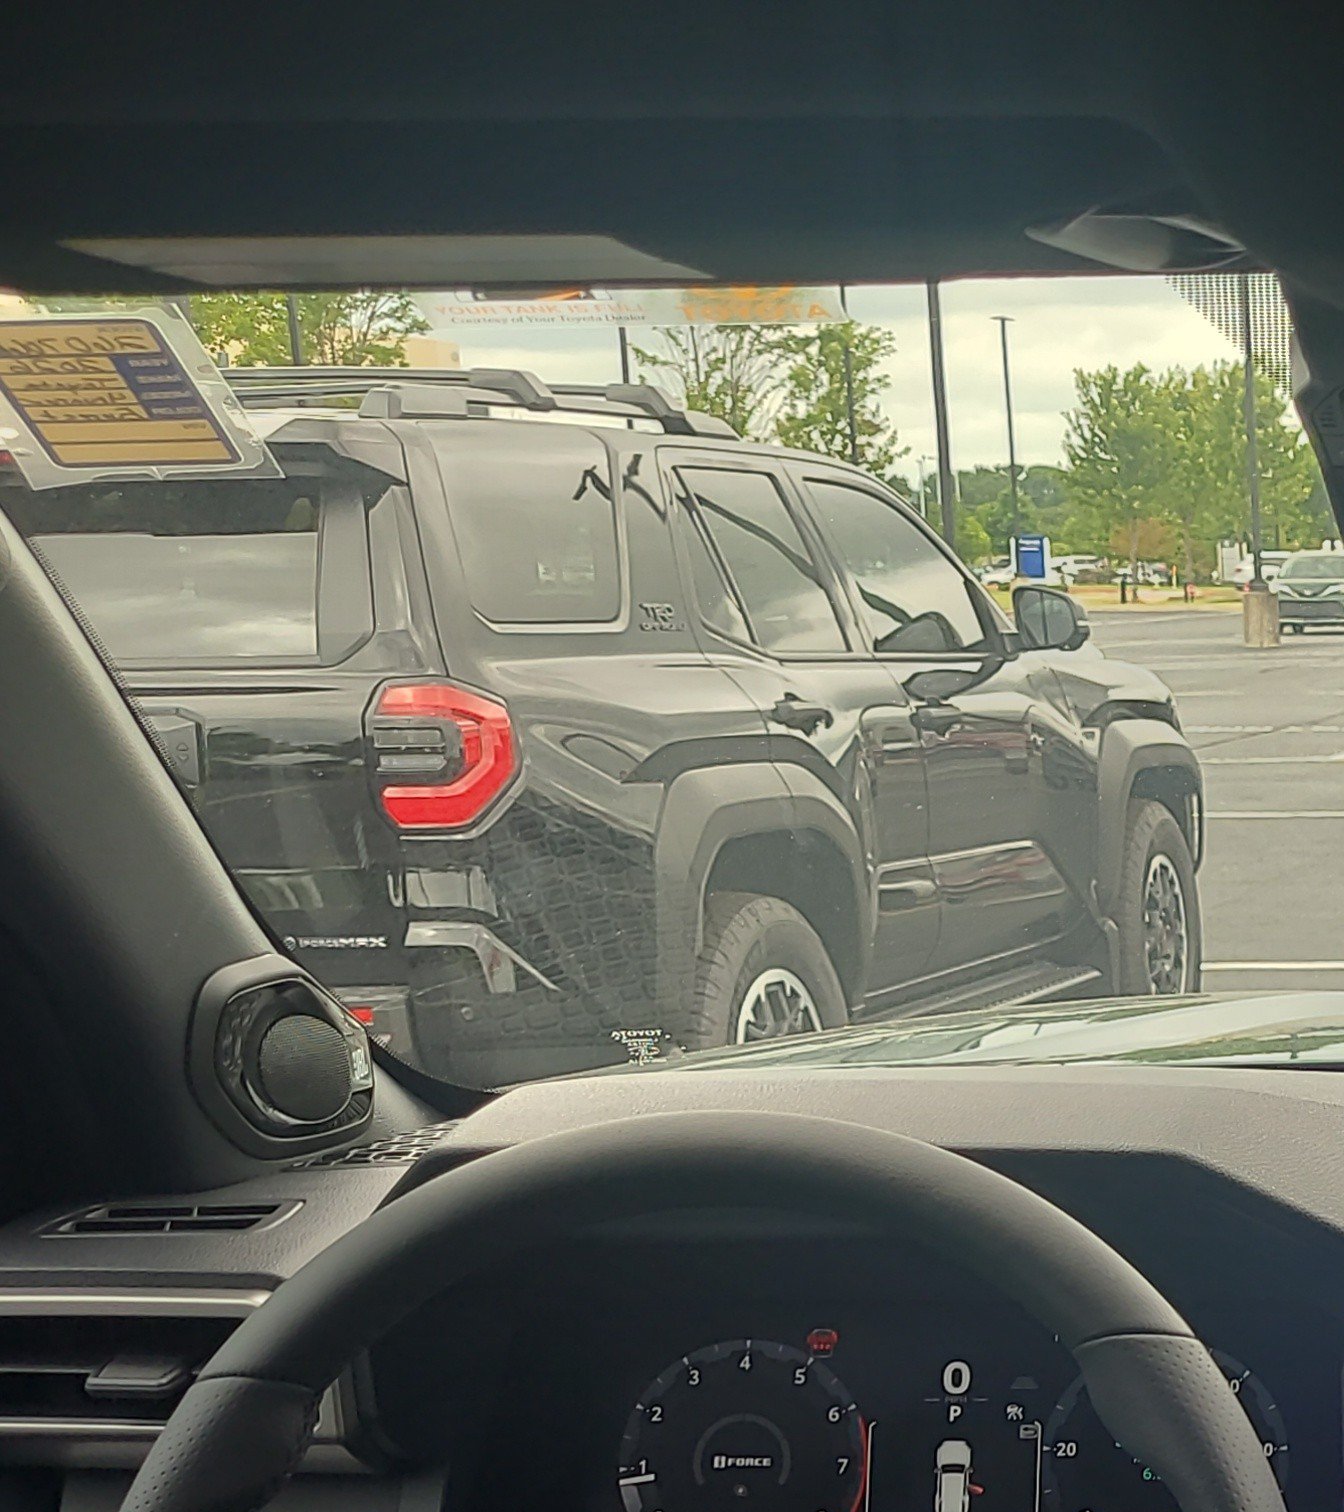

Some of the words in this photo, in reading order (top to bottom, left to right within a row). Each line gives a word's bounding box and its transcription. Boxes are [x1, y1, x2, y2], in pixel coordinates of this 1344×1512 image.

[435, 304, 496, 316] YOUR
[500, 304, 561, 315] TANK
[568, 304, 588, 315] IS
[676, 303, 832, 320] TOYOTA
[739, 1355, 752, 1371] 4
[688, 1370, 701, 1386] 3
[793, 1368, 806, 1385] 5
[941, 1359, 972, 1395] 0
[650, 1407, 664, 1422] 2
[828, 1406, 841, 1422] 6
[948, 1405, 963, 1422] P
[1055, 1442, 1078, 1457] 20
[638, 1460, 647, 1474] 1
[836, 1458, 849, 1475] 7
